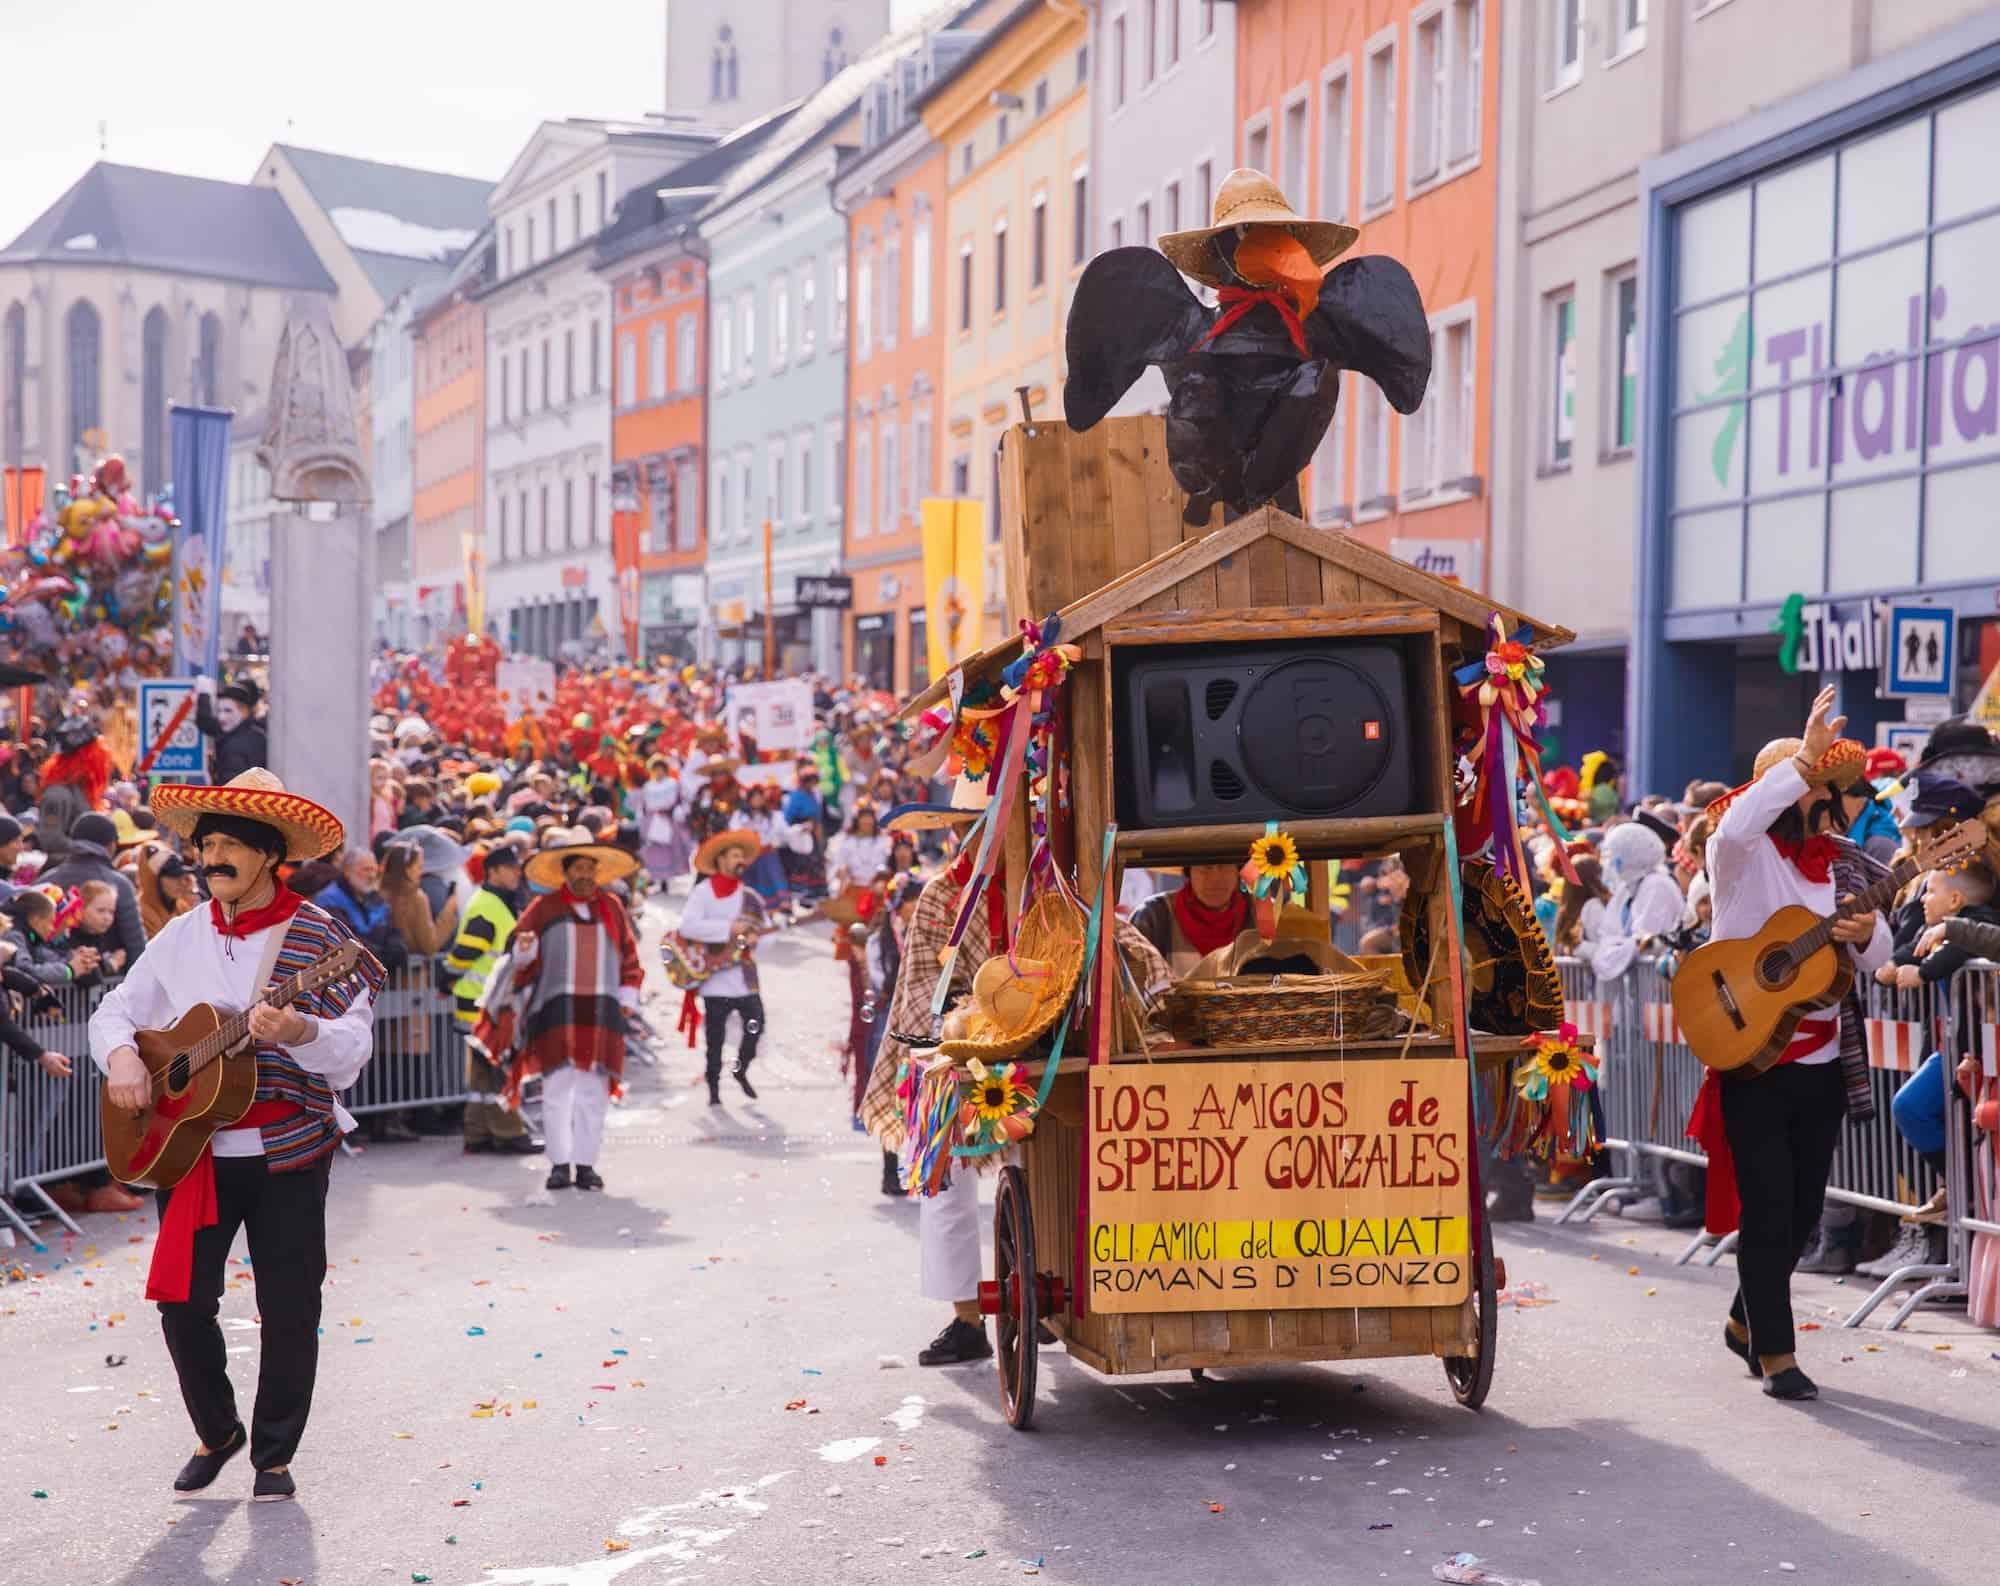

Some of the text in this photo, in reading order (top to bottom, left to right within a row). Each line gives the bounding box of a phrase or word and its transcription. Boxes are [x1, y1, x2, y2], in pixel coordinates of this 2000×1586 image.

[1766, 285, 1998, 475] Thalia
[1415, 547, 1454, 571] dm
[1798, 597, 1883, 671] Thali
[1094, 1080, 1439, 1132] LOS AMIGOS de
[1097, 1133, 1460, 1192] SPEEDY GONZALES
[1094, 1217, 1455, 1263] GLI AMICI del QUAIAT
[1093, 1265, 1257, 1292] ROMANS
[1317, 1261, 1460, 1289] ISONZO
